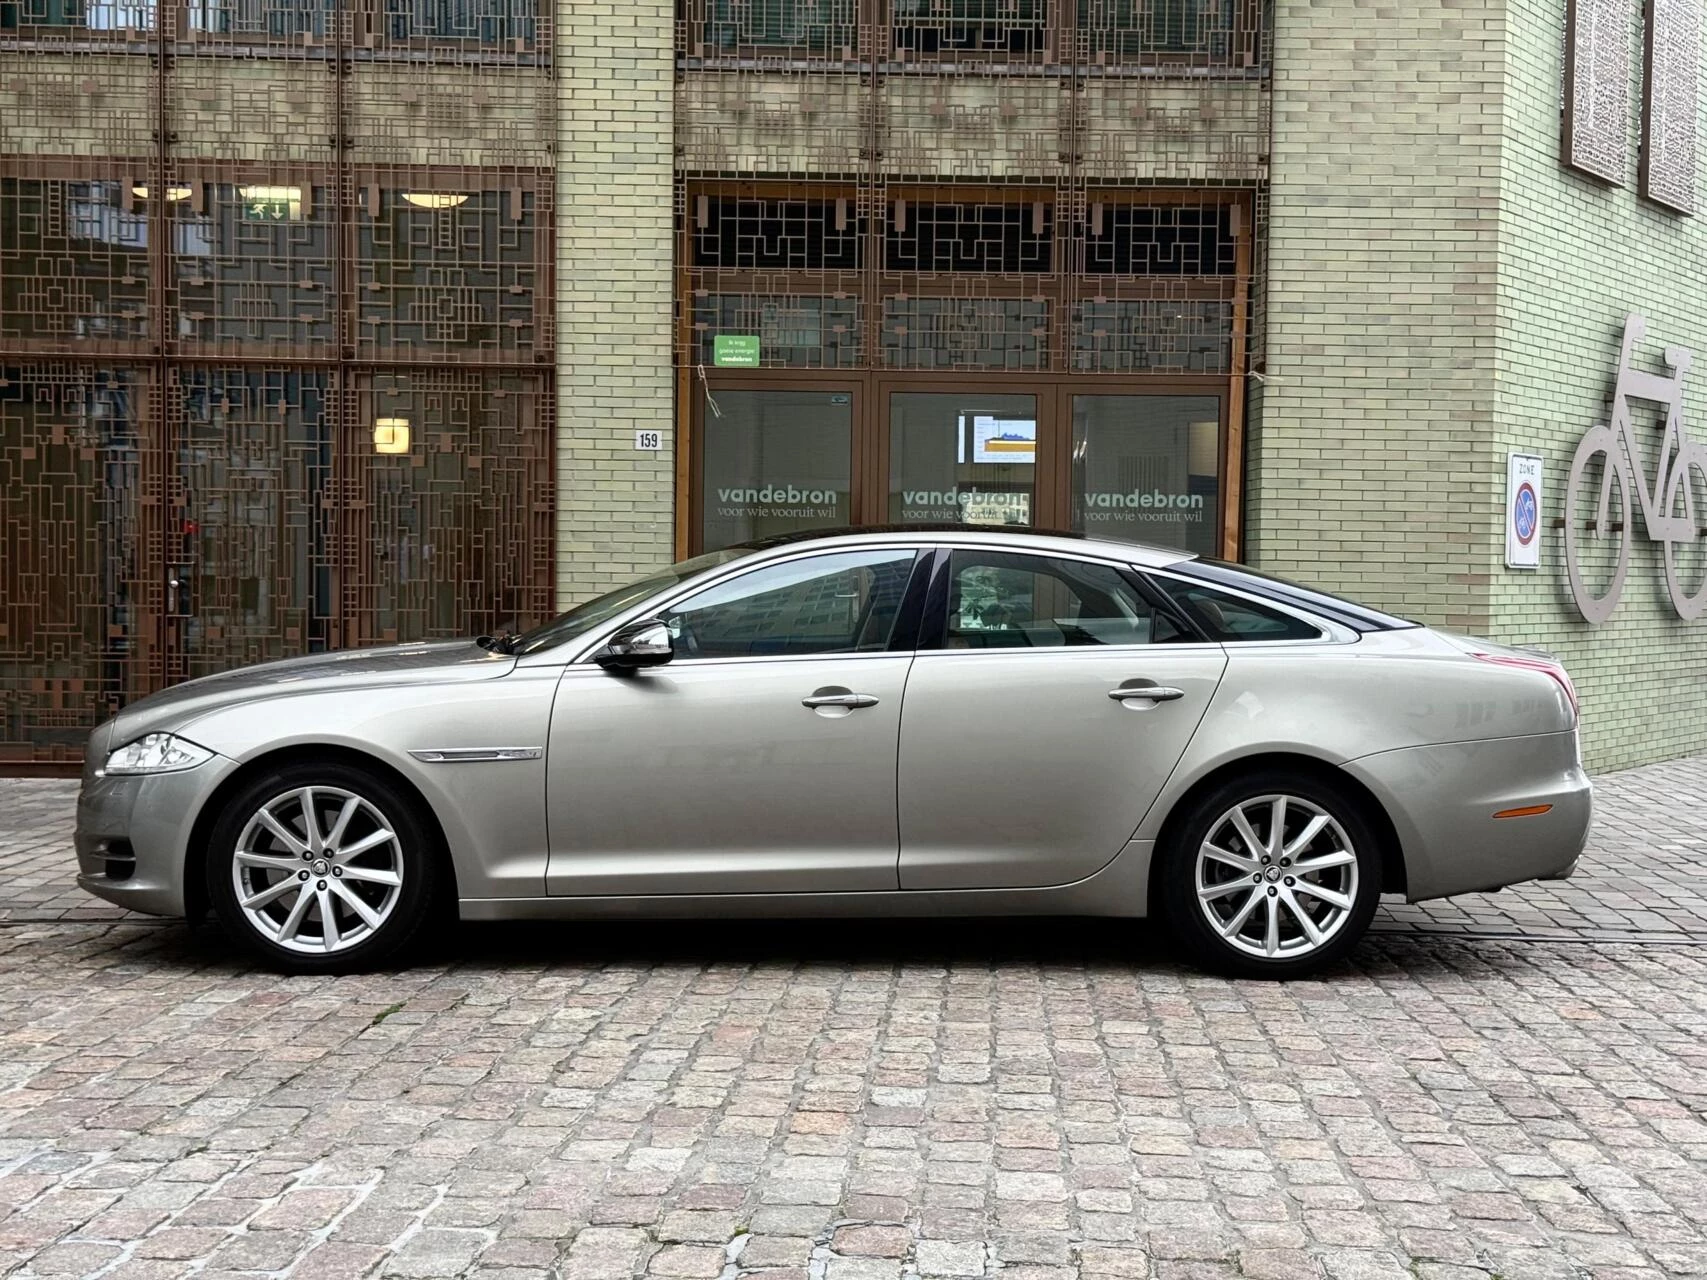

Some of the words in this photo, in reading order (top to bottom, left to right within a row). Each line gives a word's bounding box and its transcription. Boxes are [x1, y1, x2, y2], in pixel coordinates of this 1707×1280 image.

[640, 433, 658, 448] 159
[1519, 463, 1535, 475] ZONE
[717, 484, 837, 504] vandebron
[902, 486, 1021, 506] vandebron
[1084, 488, 1204, 508] vandebron
[717, 506, 746, 517] voor
[747, 505, 769, 517] wie
[771, 506, 815, 518] vooruit
[817, 506, 837, 518] wil
[902, 509, 928, 519] voor
[931, 508, 954, 519] wie
[1084, 511, 1112, 521] voor
[1114, 510, 1136, 521] wie
[1138, 510, 1182, 522] vooruit
[1184, 510, 1203, 522] wil
